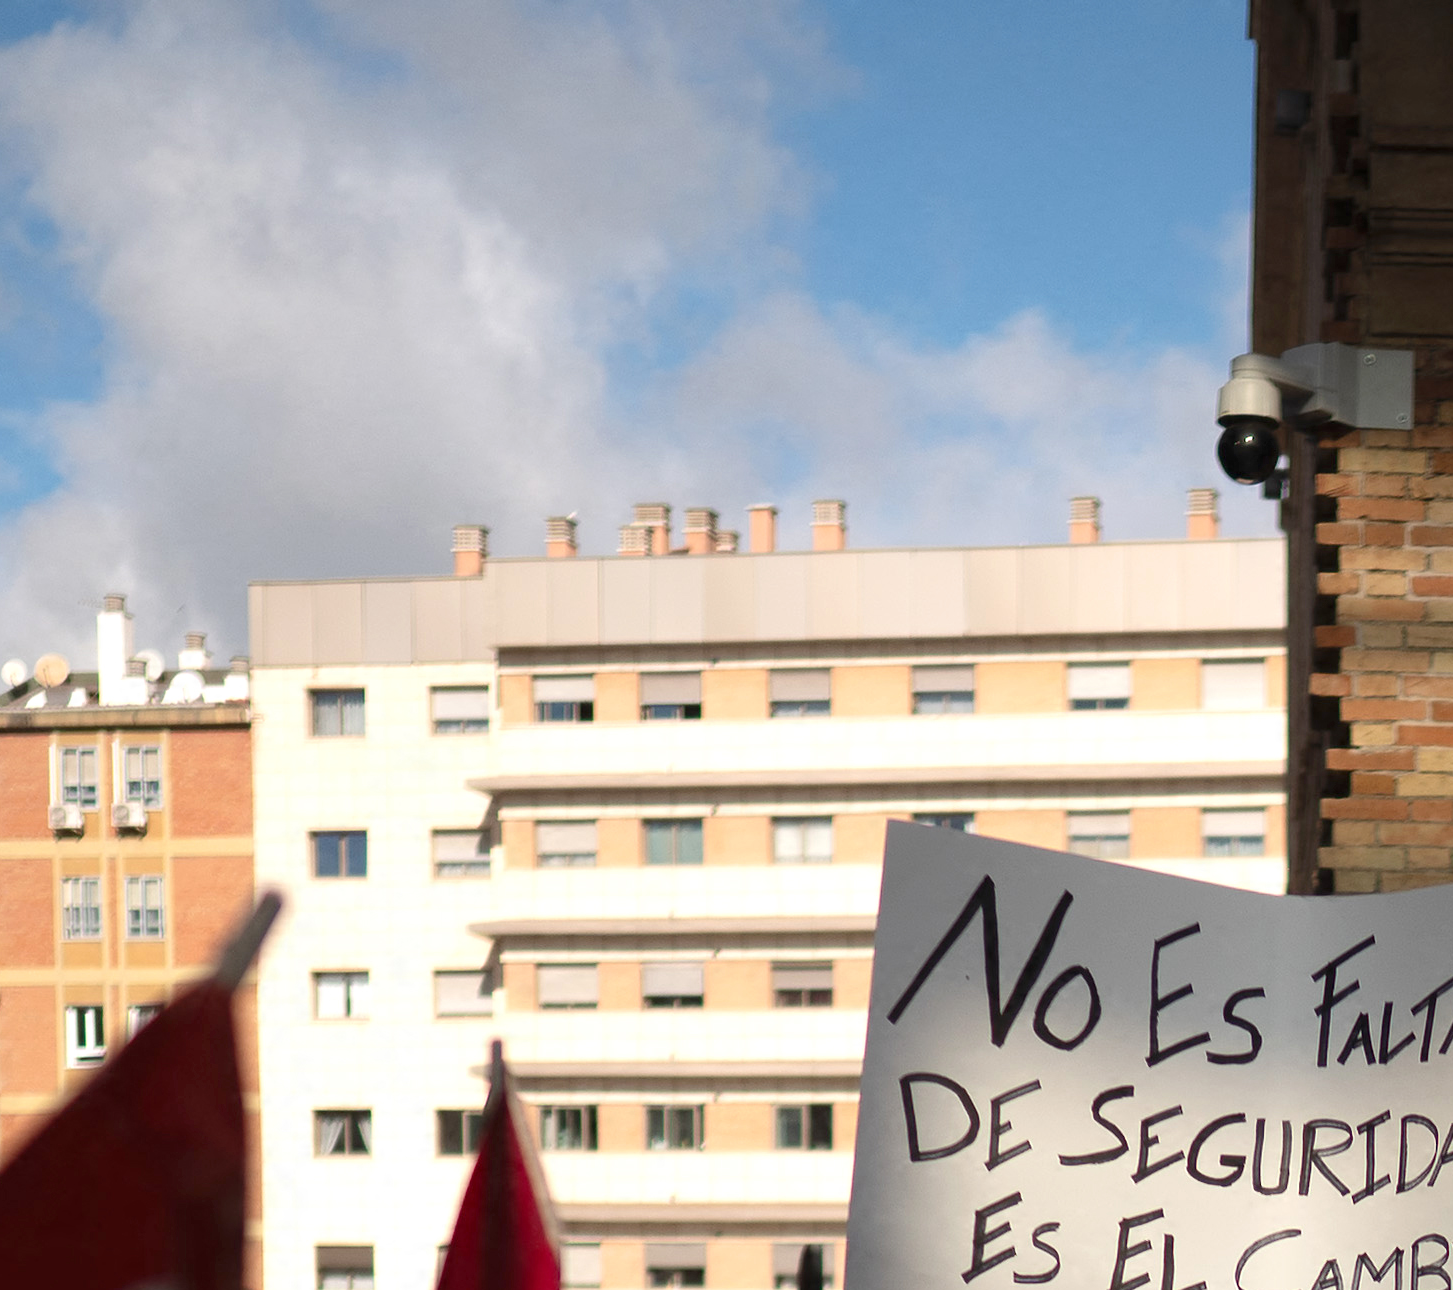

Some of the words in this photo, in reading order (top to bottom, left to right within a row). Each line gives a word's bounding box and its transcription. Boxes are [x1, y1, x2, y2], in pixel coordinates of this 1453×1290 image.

[887, 874, 1102, 1052] NO
[1144, 922, 1266, 1067] ES
[899, 1072, 1041, 1171] DE
[960, 1193, 1061, 1284] ES
